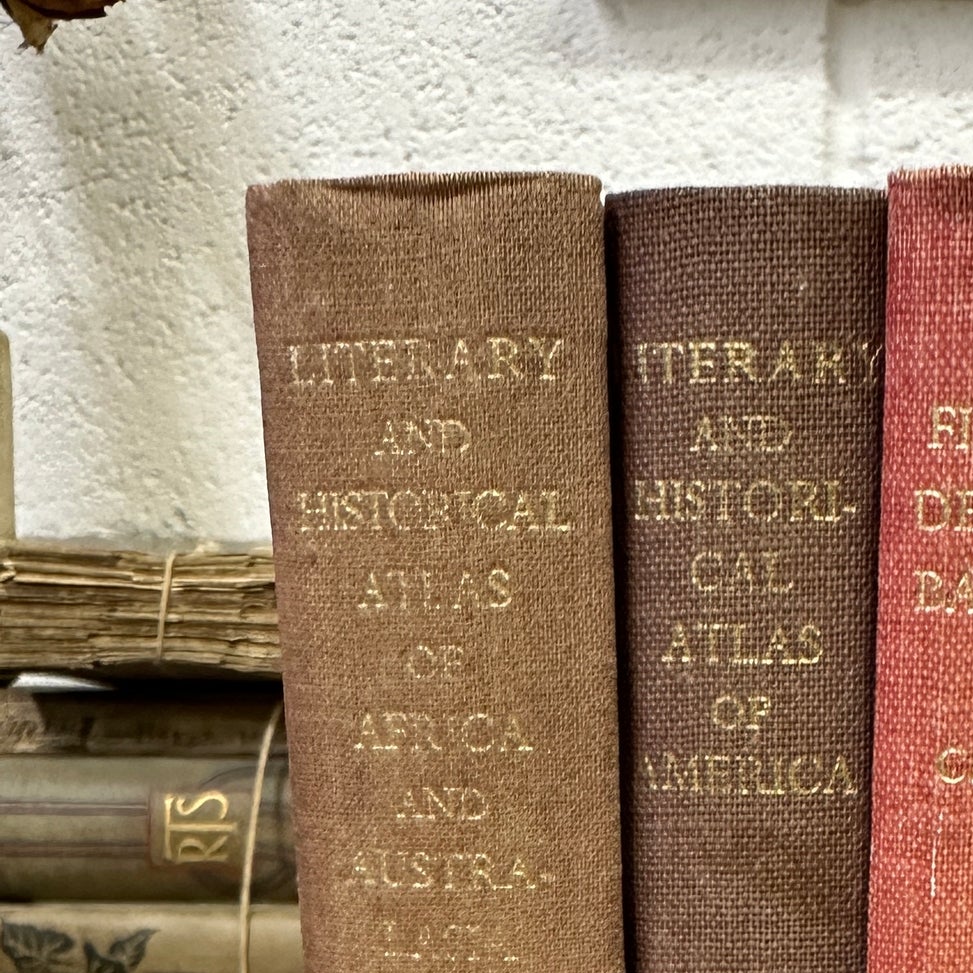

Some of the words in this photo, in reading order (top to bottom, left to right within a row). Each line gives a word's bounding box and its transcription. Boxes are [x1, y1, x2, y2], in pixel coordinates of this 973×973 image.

[288, 335, 564, 386] LITERARY
[374, 417, 472, 456] AND
[690, 414, 793, 452] AND
[298, 487, 574, 532] HISTORICAL
[356, 567, 513, 611] ATLAS
[690, 549, 794, 592] CAL
[405, 643, 465, 681] OF
[660, 620, 824, 665] ATLAS
[353, 711, 535, 752] AFRICA
[711, 695, 772, 730] OF
[396, 785, 491, 822] AND
